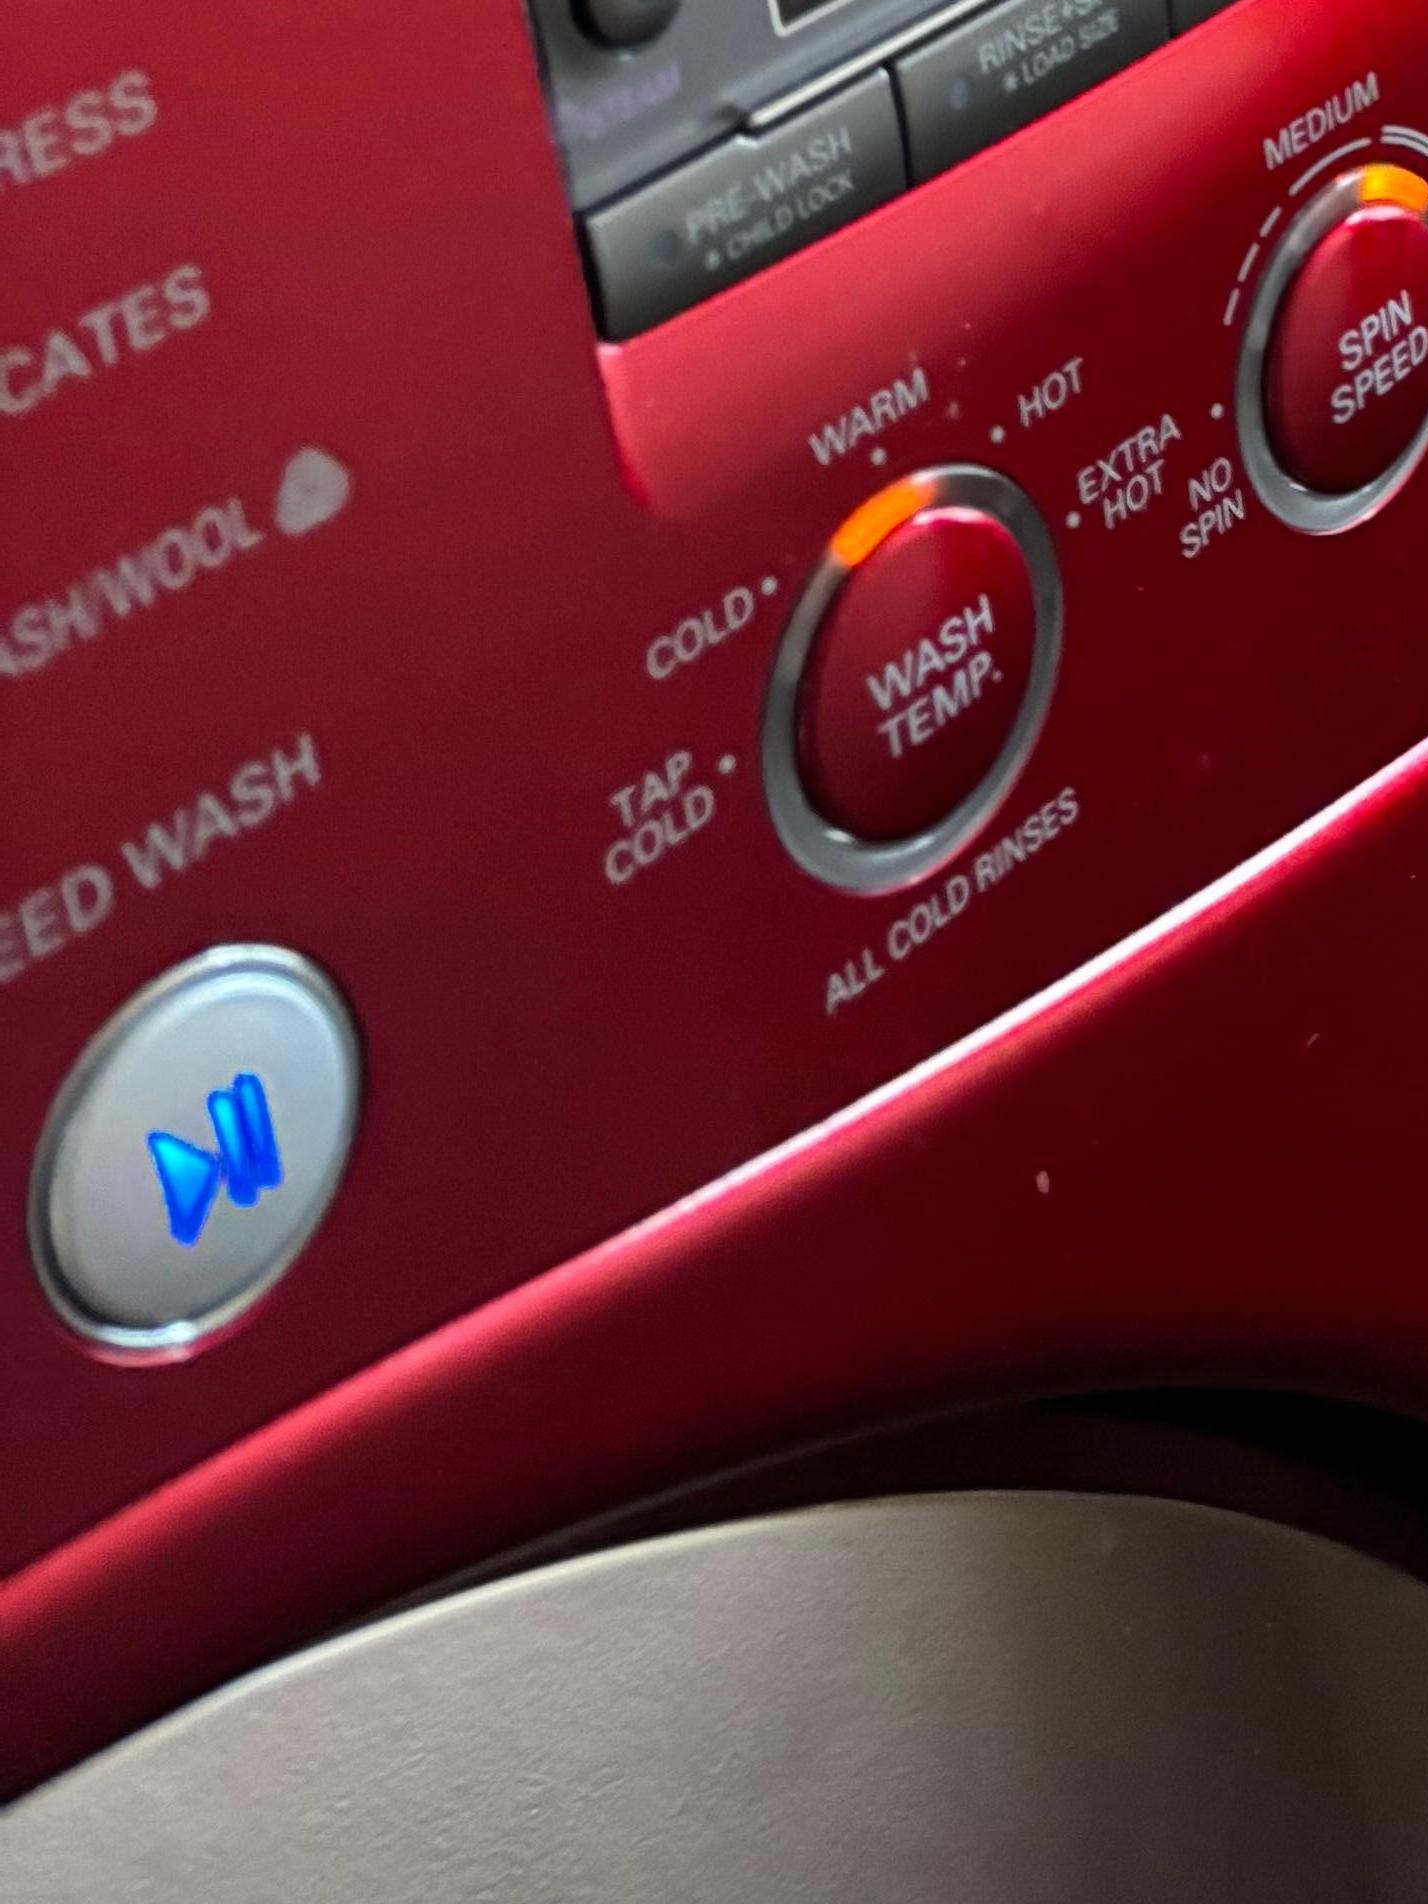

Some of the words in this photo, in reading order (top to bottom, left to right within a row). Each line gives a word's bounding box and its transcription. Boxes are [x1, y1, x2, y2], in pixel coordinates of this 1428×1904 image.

[1021, 35, 1075, 88] LOAD
[1079, 7, 1121, 51] SIZE
[1262, 70, 1381, 171] MEDIUM
[727, 208, 795, 260] CHILD
[799, 167, 855, 220] LOCK
[0, 263, 212, 417] CATES
[1338, 289, 1413, 372] SPIN
[807, 367, 931, 467] WARM
[1017, 357, 1085, 427] HOT
[1077, 413, 1183, 507] EXTRA
[1101, 458, 1168, 530] HOT
[1187, 456, 1234, 511] NO
[1179, 489, 1247, 560] SPIN
[644, 587, 755, 681] COLD
[866, 593, 997, 712] WASH
[877, 649, 1005, 759] TEMP.
[121, 730, 323, 891] WASH
[602, 784, 716, 887] COLD
[608, 749, 694, 829] TAP
[824, 947, 884, 1016] ALL
[887, 874, 970, 960] COLD
[975, 786, 1081, 891] RINSES
